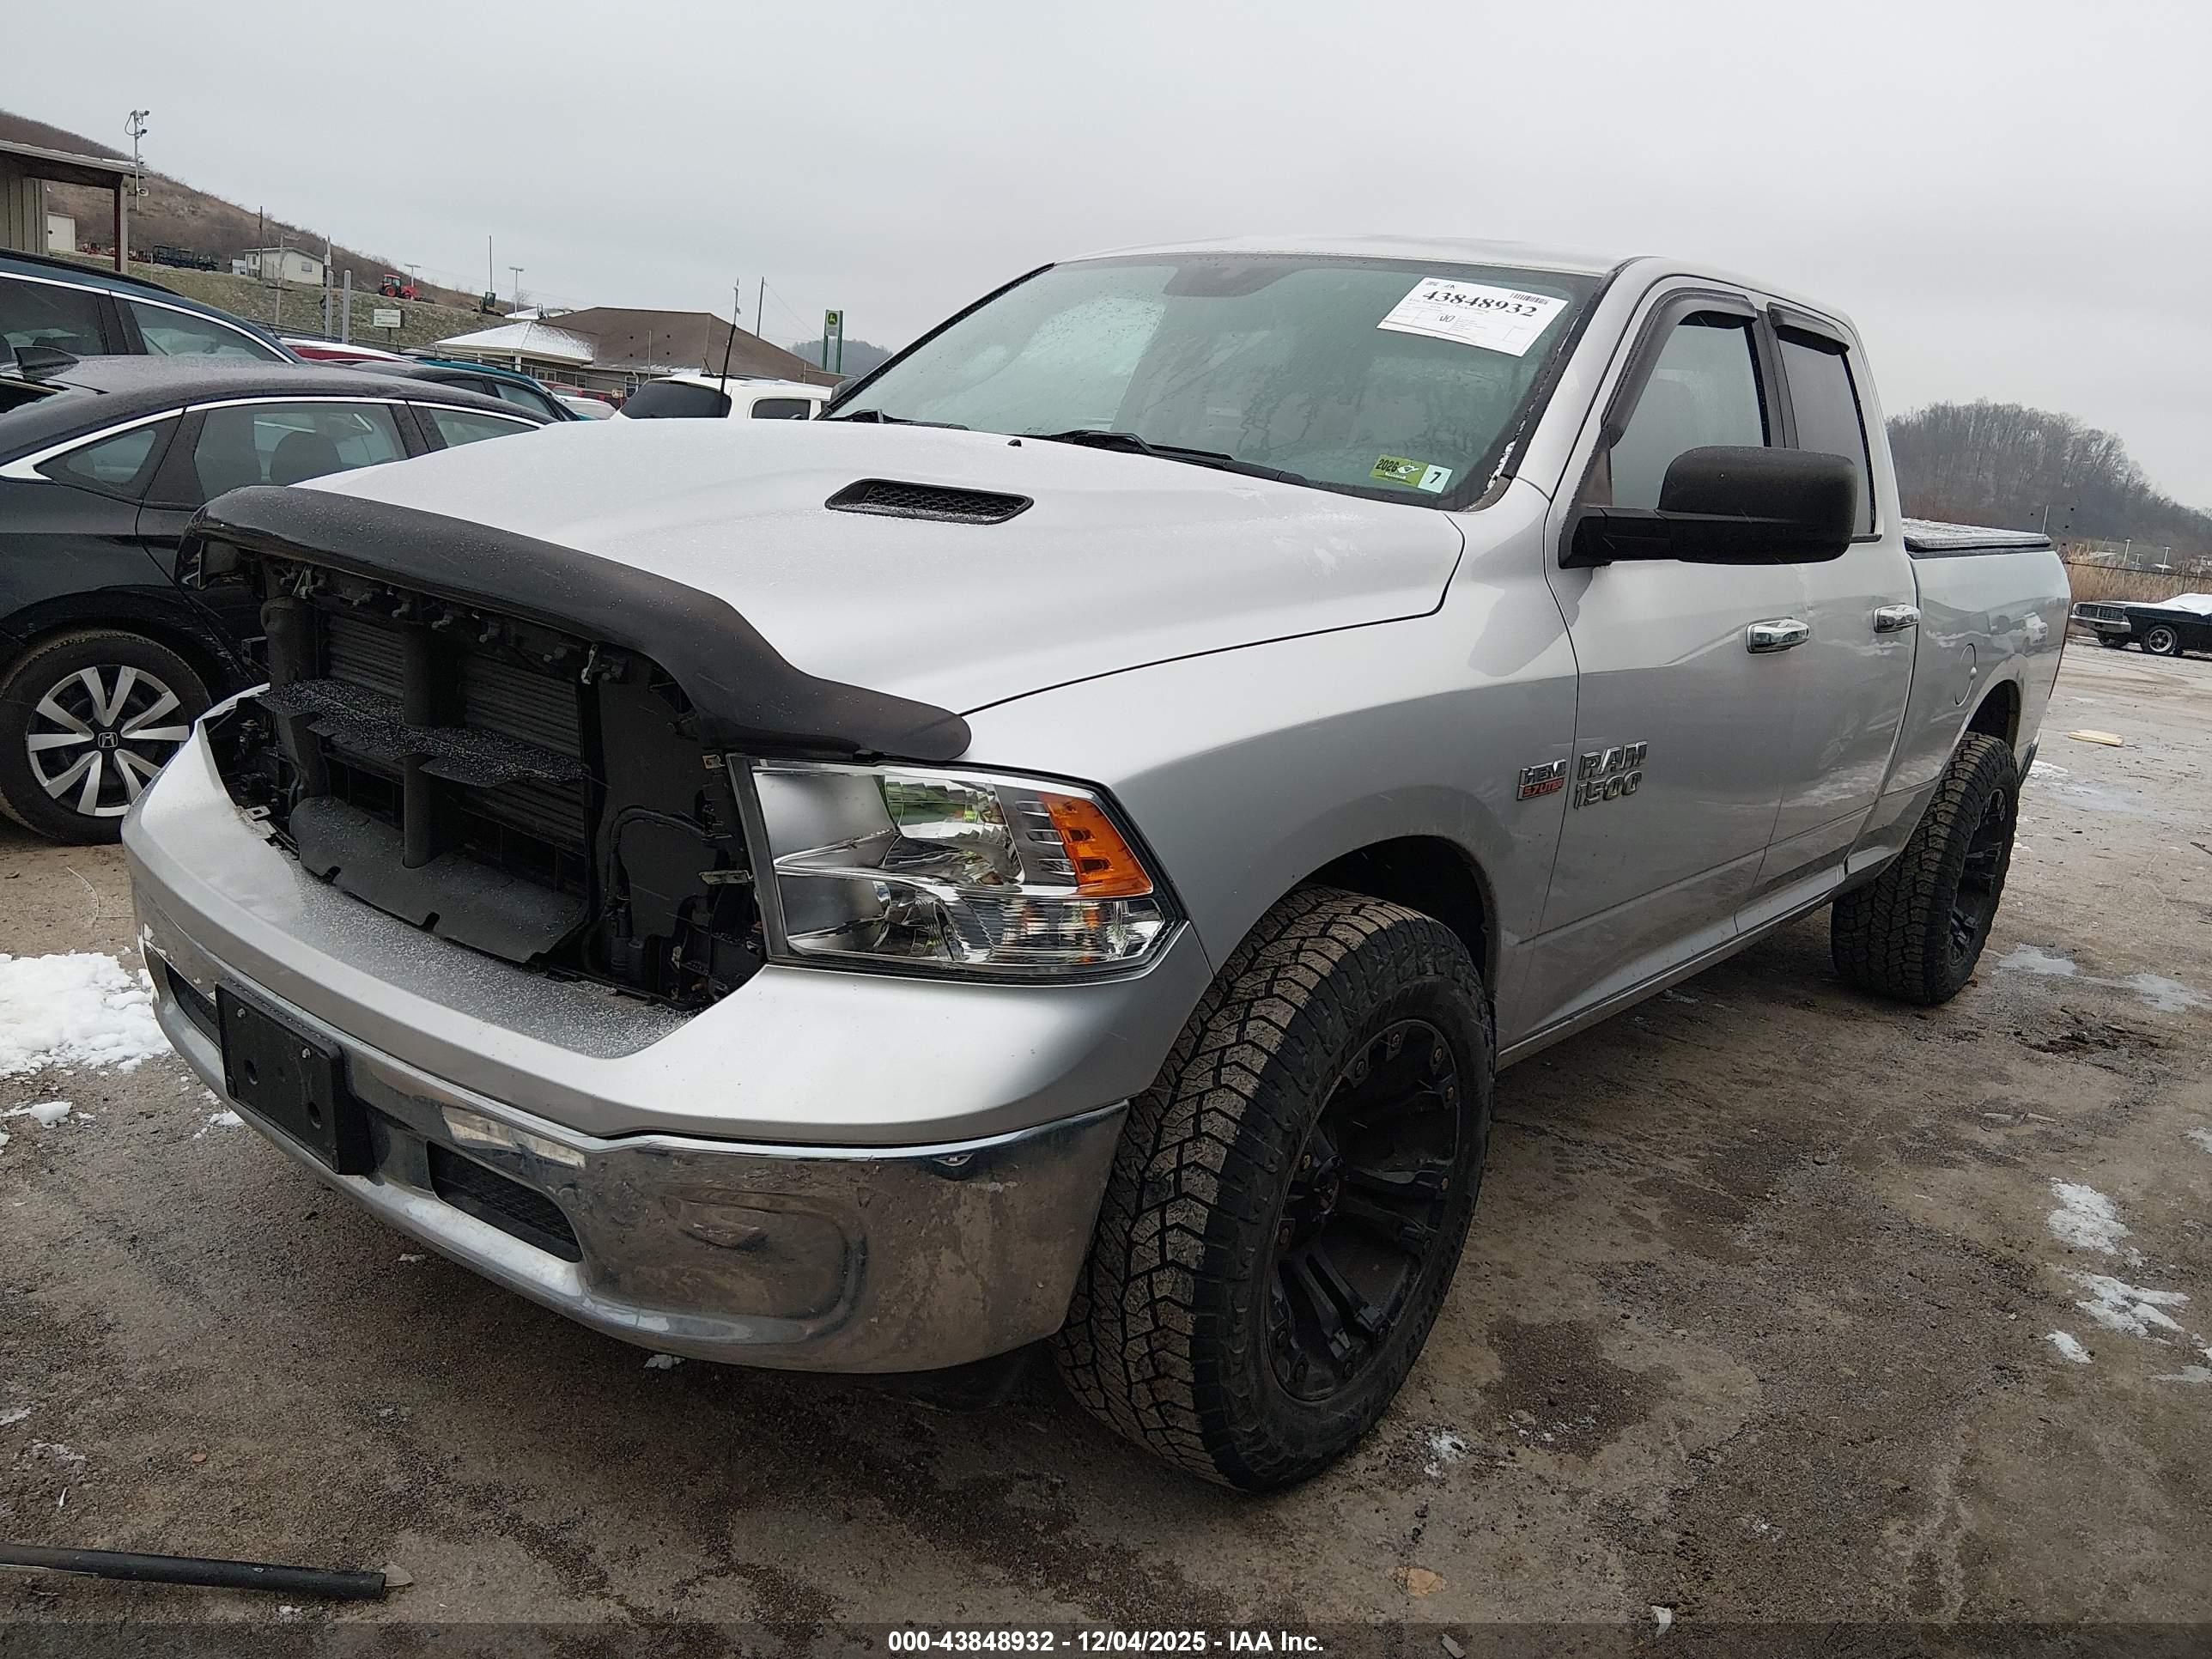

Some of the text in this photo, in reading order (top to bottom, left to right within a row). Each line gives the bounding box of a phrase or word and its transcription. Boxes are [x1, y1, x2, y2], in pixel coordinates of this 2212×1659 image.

[1422, 290, 1539, 318] 43848932
[1375, 459, 1400, 473] 2026
[1429, 471, 1442, 484] 7
[1577, 740, 1649, 781] RAM
[1573, 770, 1643, 811] 1500
